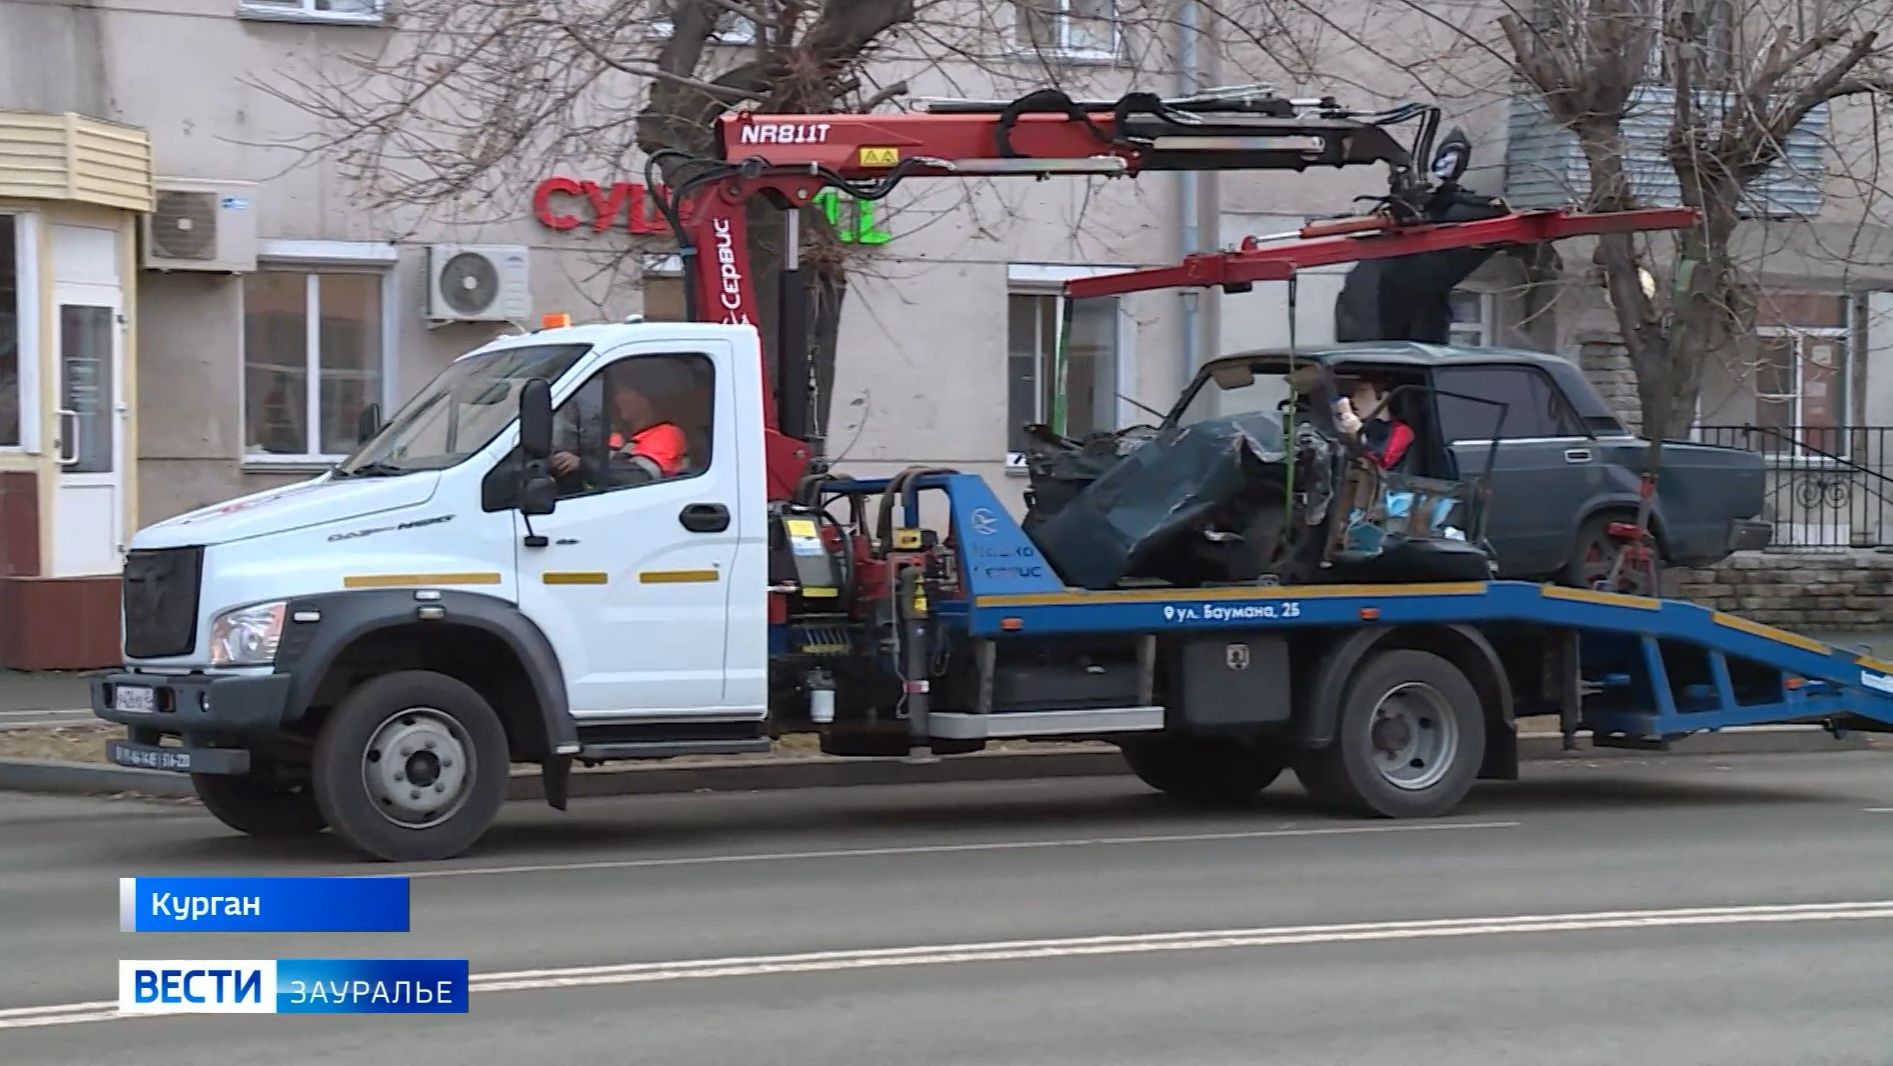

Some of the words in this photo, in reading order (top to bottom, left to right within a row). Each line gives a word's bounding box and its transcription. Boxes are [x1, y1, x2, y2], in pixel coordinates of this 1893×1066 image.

[740, 123, 831, 144] NR811T
[1177, 607, 1200, 623] ул.
[1203, 603, 1280, 621] Баумана,
